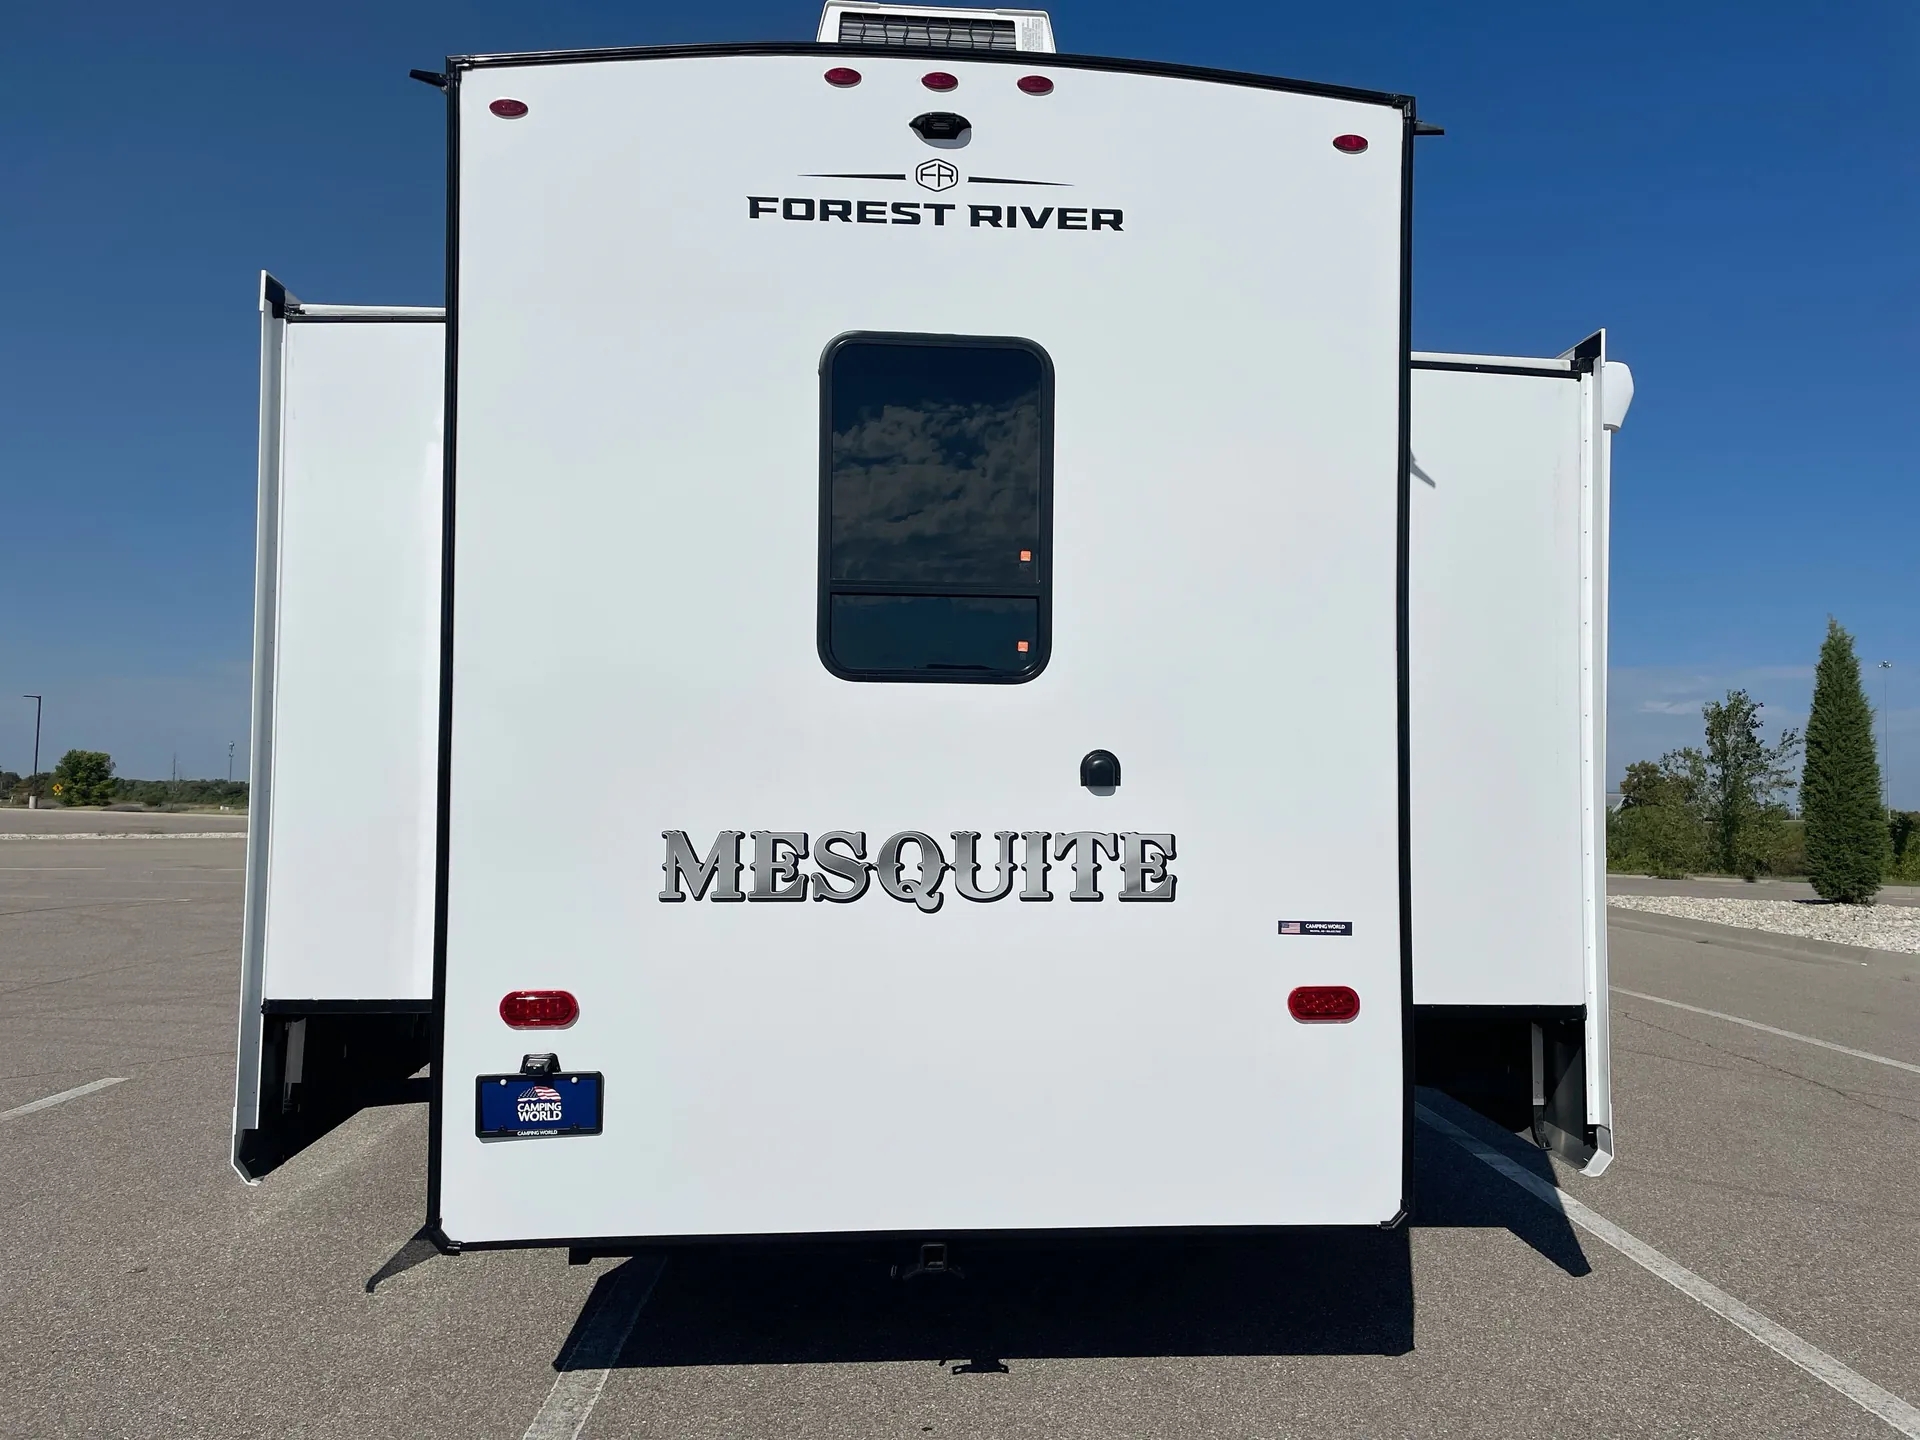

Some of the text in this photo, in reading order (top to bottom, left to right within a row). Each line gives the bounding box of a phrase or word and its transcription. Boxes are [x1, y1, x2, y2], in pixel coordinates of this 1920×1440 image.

[746, 196, 1124, 231] FOREST RIVER
[659, 830, 1177, 914] MESQUITE
[517, 1102, 562, 1112] CAMPING
[517, 1111, 562, 1122] WORLD
